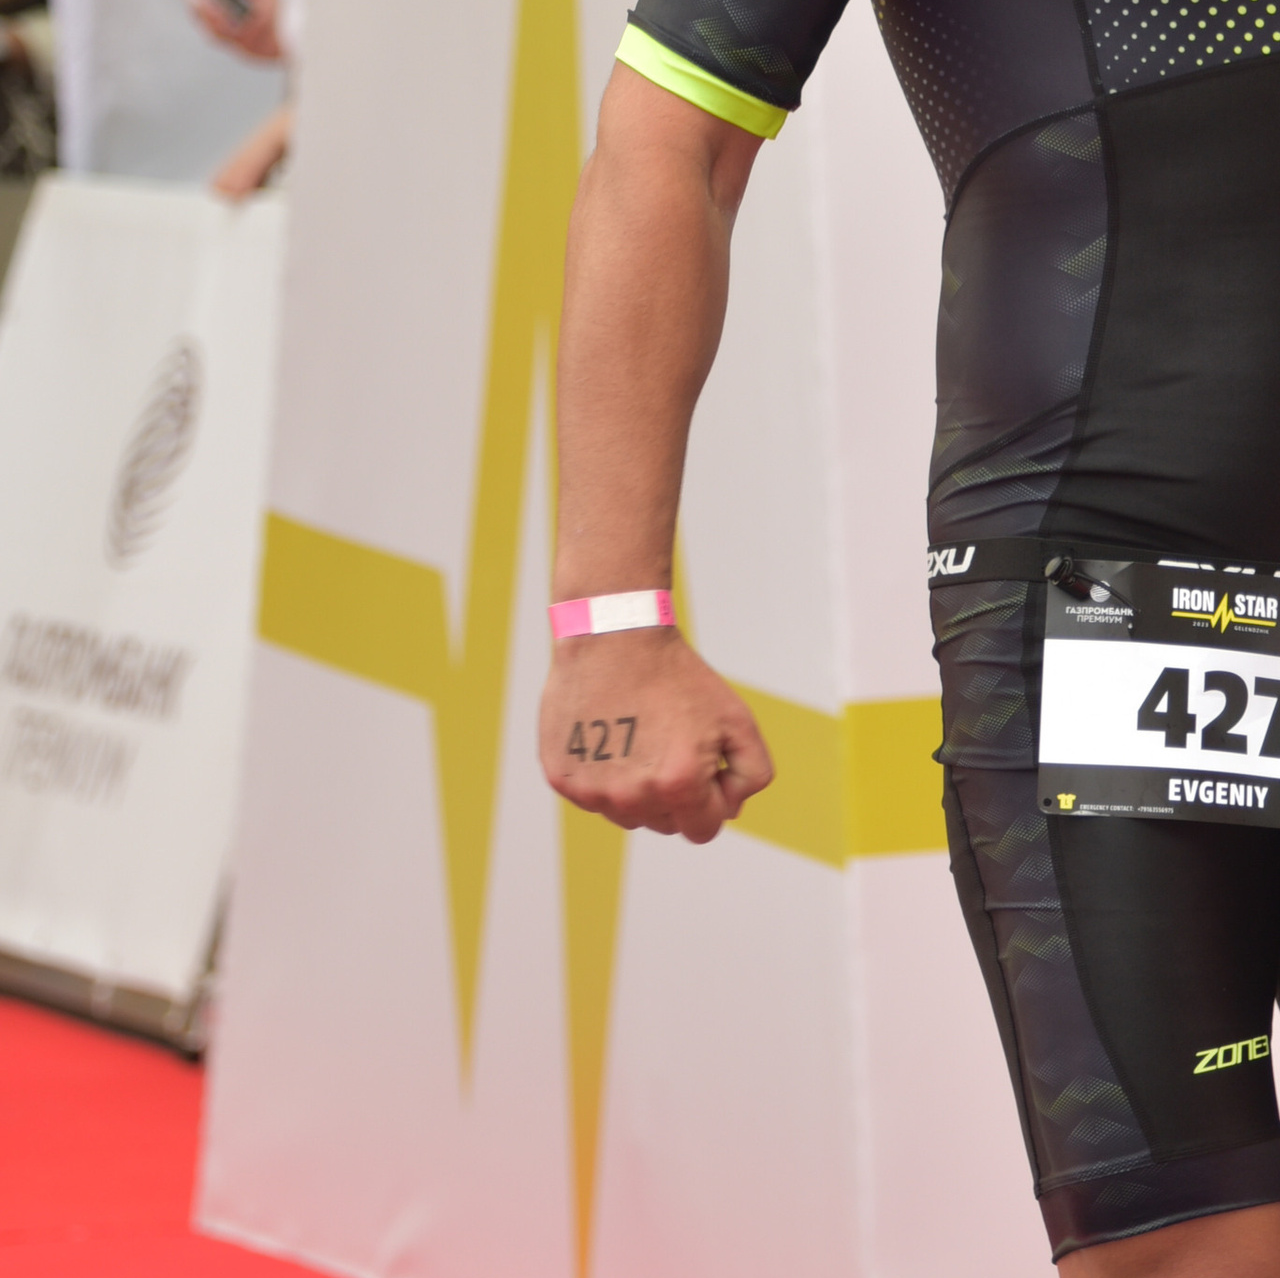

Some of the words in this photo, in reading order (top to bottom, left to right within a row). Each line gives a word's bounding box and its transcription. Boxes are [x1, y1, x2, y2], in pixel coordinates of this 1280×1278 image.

[1065, 606, 1134, 617] ГАЗПРОМБАНК
[1172, 587, 1215, 612] IRON
[1234, 593, 1278, 619] STAR
[1077, 614, 1123, 624] ПРЕМИУМ
[566, 716, 638, 763] 427
[1168, 778, 1268, 809] EVGENIY
